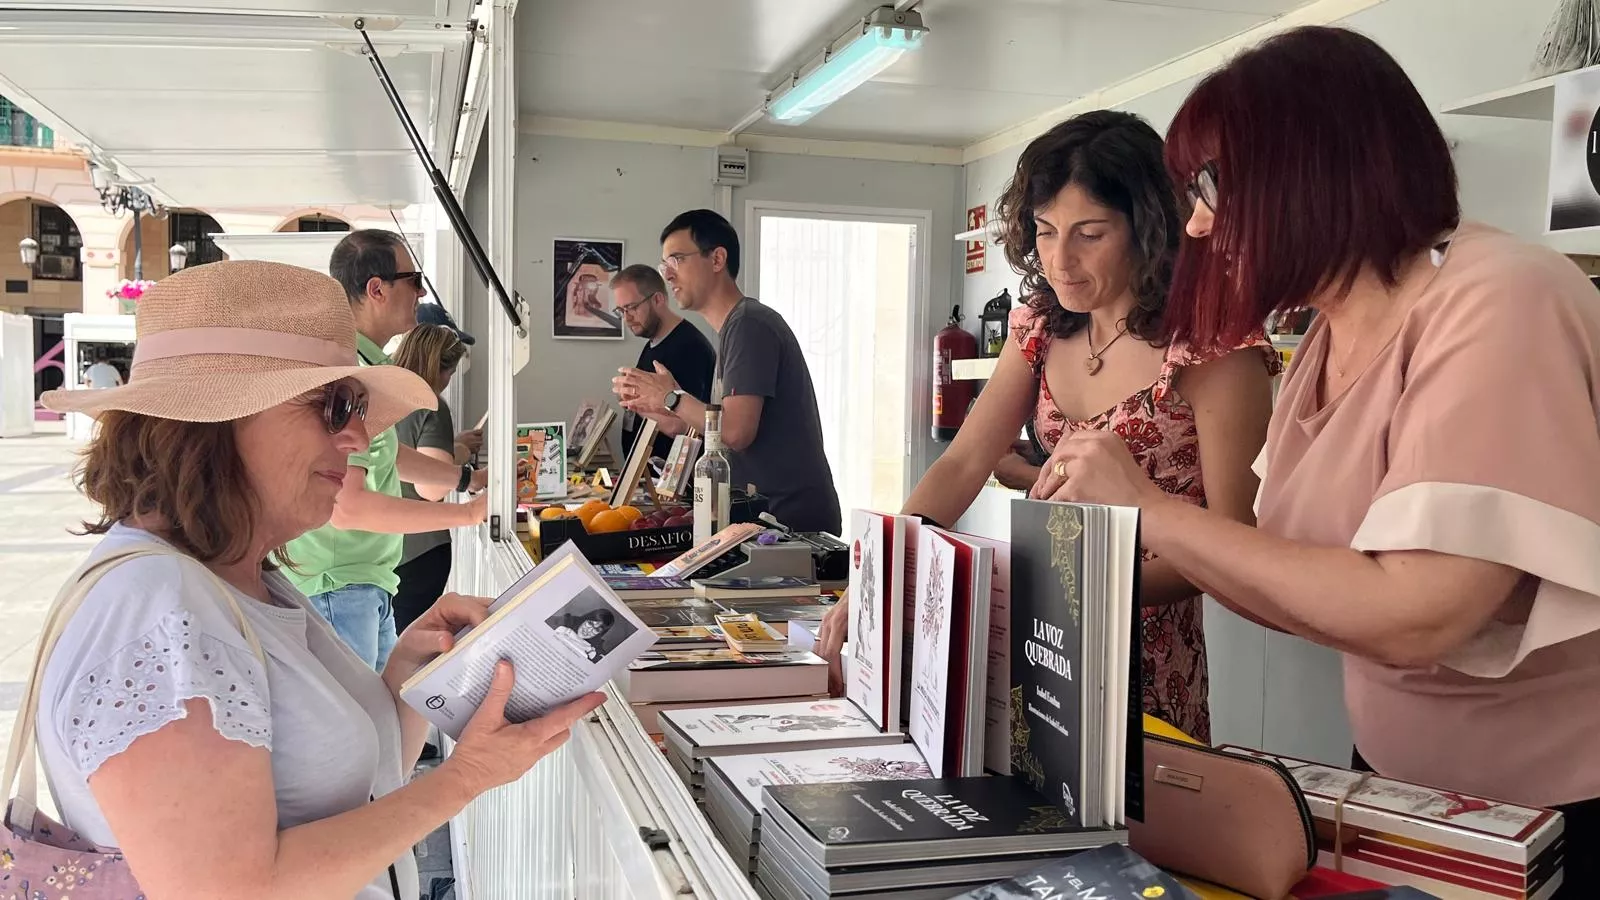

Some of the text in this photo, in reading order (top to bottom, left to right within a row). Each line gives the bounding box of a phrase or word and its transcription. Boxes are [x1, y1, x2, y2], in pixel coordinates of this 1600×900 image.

[1033, 617, 1064, 650] LA VOZ
[1024, 639, 1073, 681] QUEBRADA
[901, 789, 975, 832] QUEBRADA
[934, 794, 990, 822] LA VOZ
